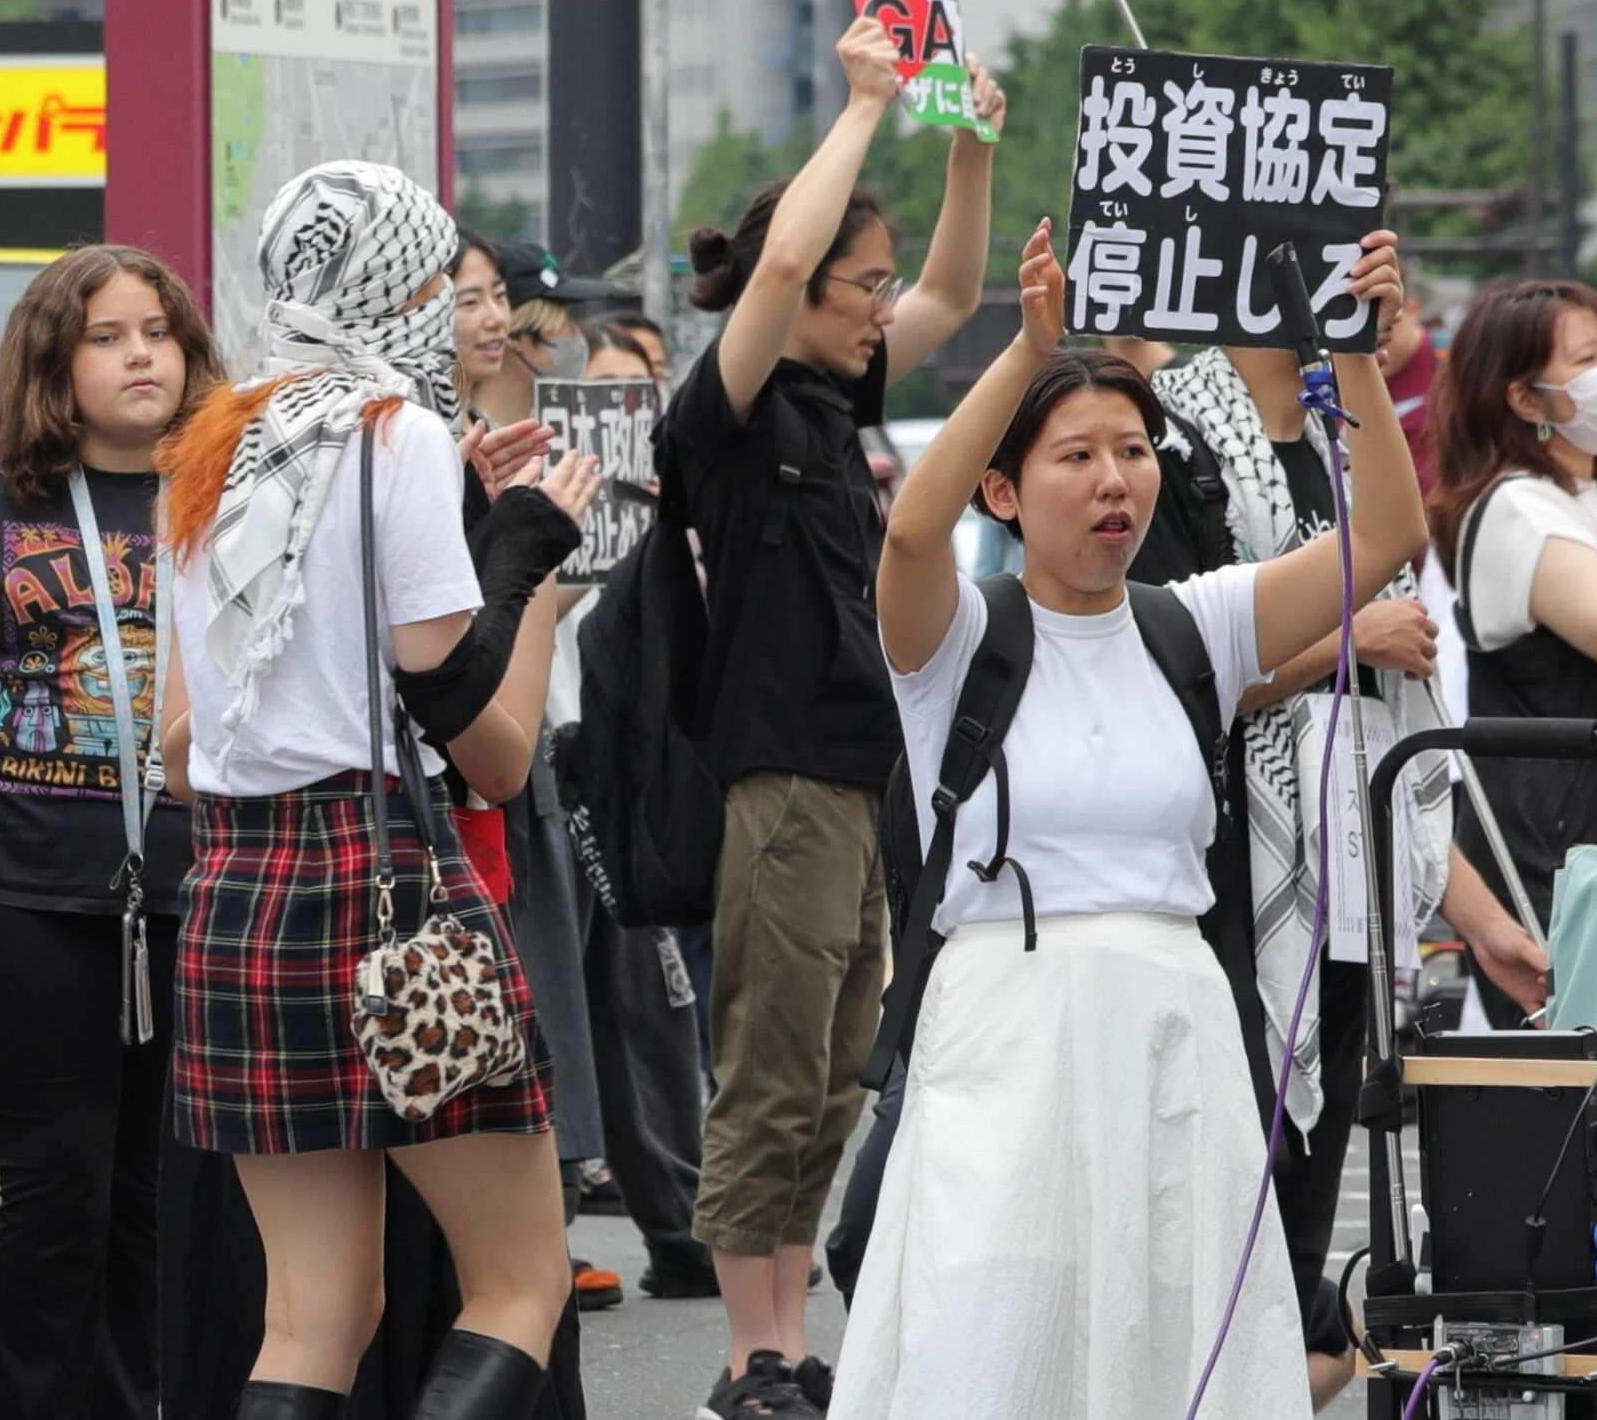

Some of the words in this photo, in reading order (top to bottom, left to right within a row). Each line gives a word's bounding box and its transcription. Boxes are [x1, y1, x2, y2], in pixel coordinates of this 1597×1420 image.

[1110, 57, 1136, 75] とう
[1192, 62, 1204, 78] し
[1260, 68, 1300, 87] きょう
[1342, 72, 1367, 91] てい
[1078, 74, 1387, 209] 投資協定
[1099, 199, 1129, 220] てい
[1185, 204, 1199, 223] し
[1064, 219, 1373, 341] 停止しろ
[1, 755, 87, 788] BIKINI
